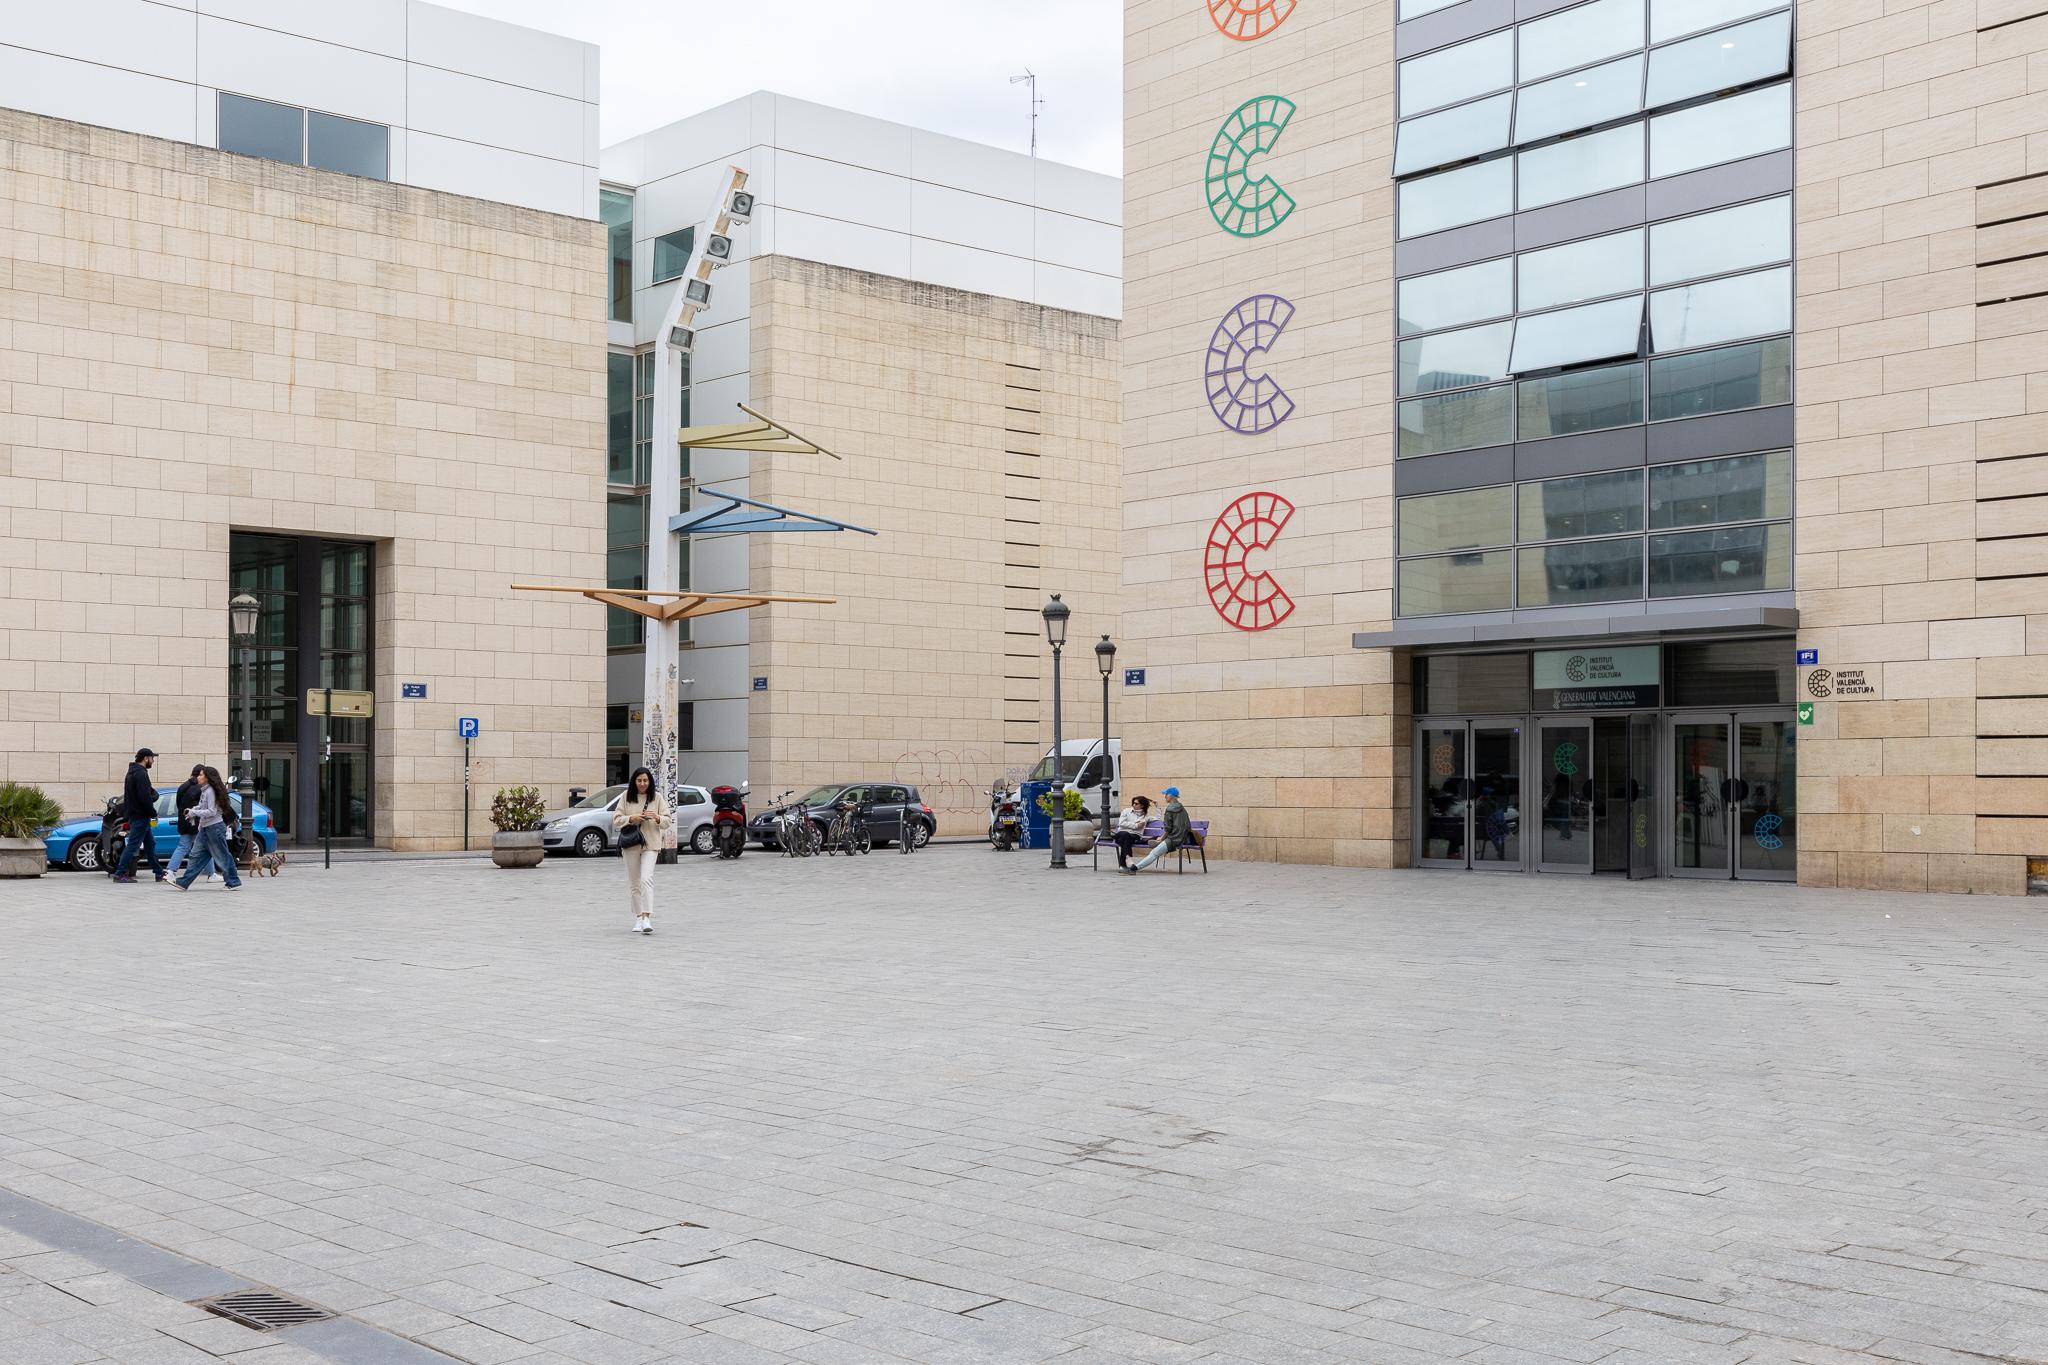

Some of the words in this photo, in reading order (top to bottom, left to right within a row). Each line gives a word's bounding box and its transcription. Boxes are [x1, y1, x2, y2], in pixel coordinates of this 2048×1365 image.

[1836, 677, 1866, 686] VALENCIÀ
[1560, 691, 1597, 702] GENERALITAT
[1598, 690, 1636, 701] VALENCIANA
[462, 719, 475, 736] P
